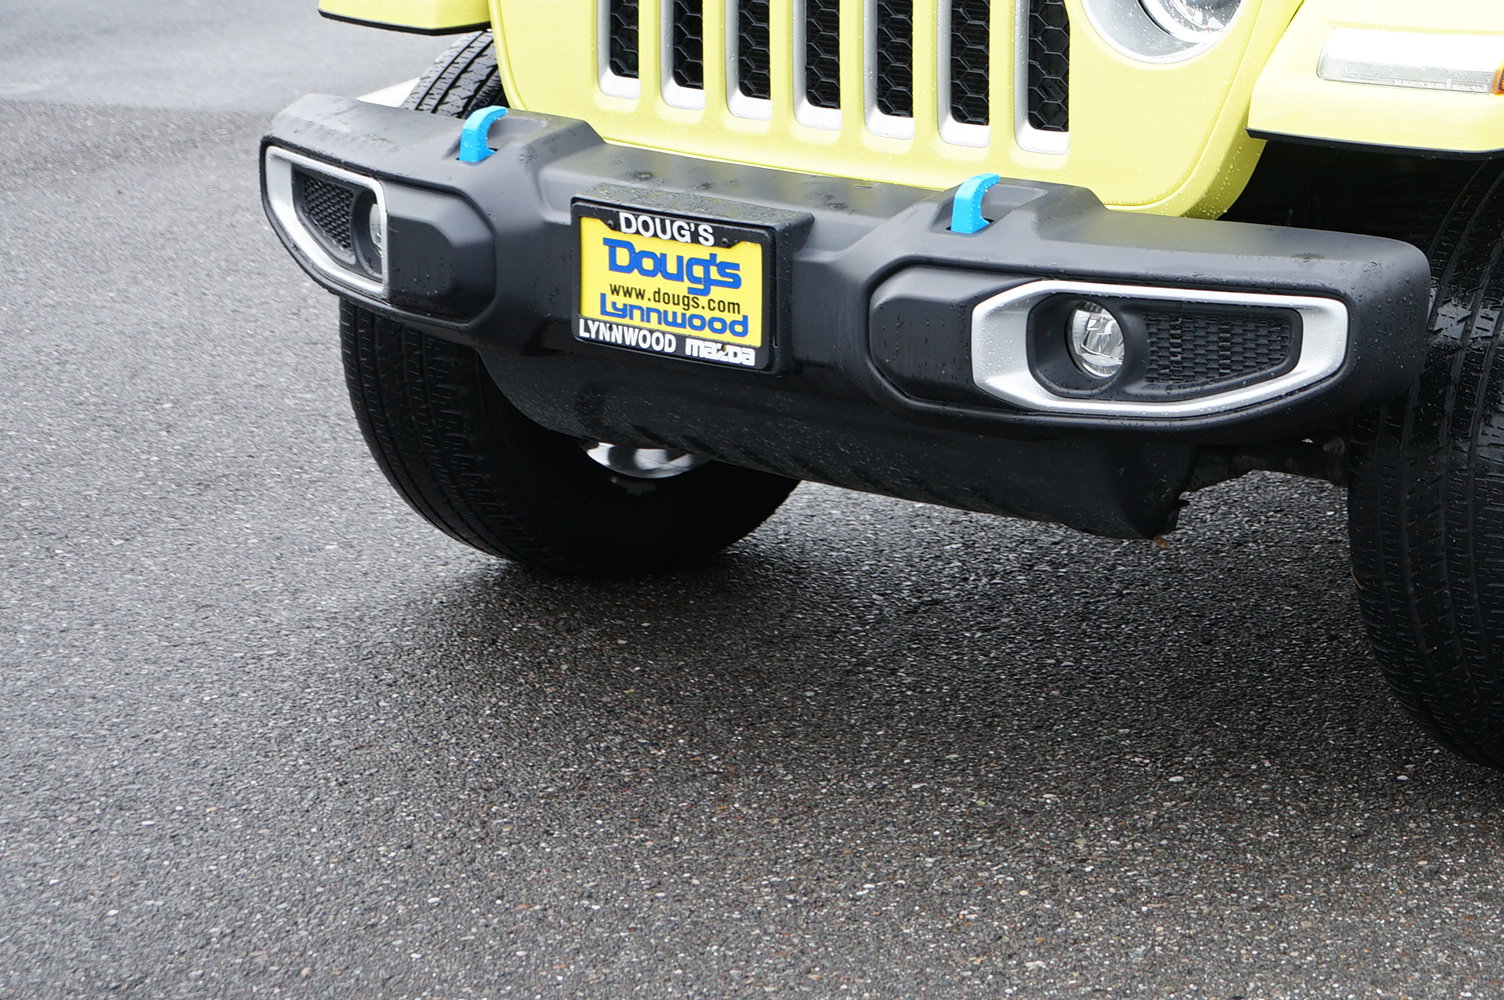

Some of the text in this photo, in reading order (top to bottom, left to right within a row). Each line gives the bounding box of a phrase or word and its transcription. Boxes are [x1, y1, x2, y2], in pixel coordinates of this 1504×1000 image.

[618, 211, 716, 247] DOUG'S
[600, 292, 749, 338] Lynnwood
[609, 282, 741, 315] www.dougs.com
[578, 318, 677, 353] LYNNWOOD
